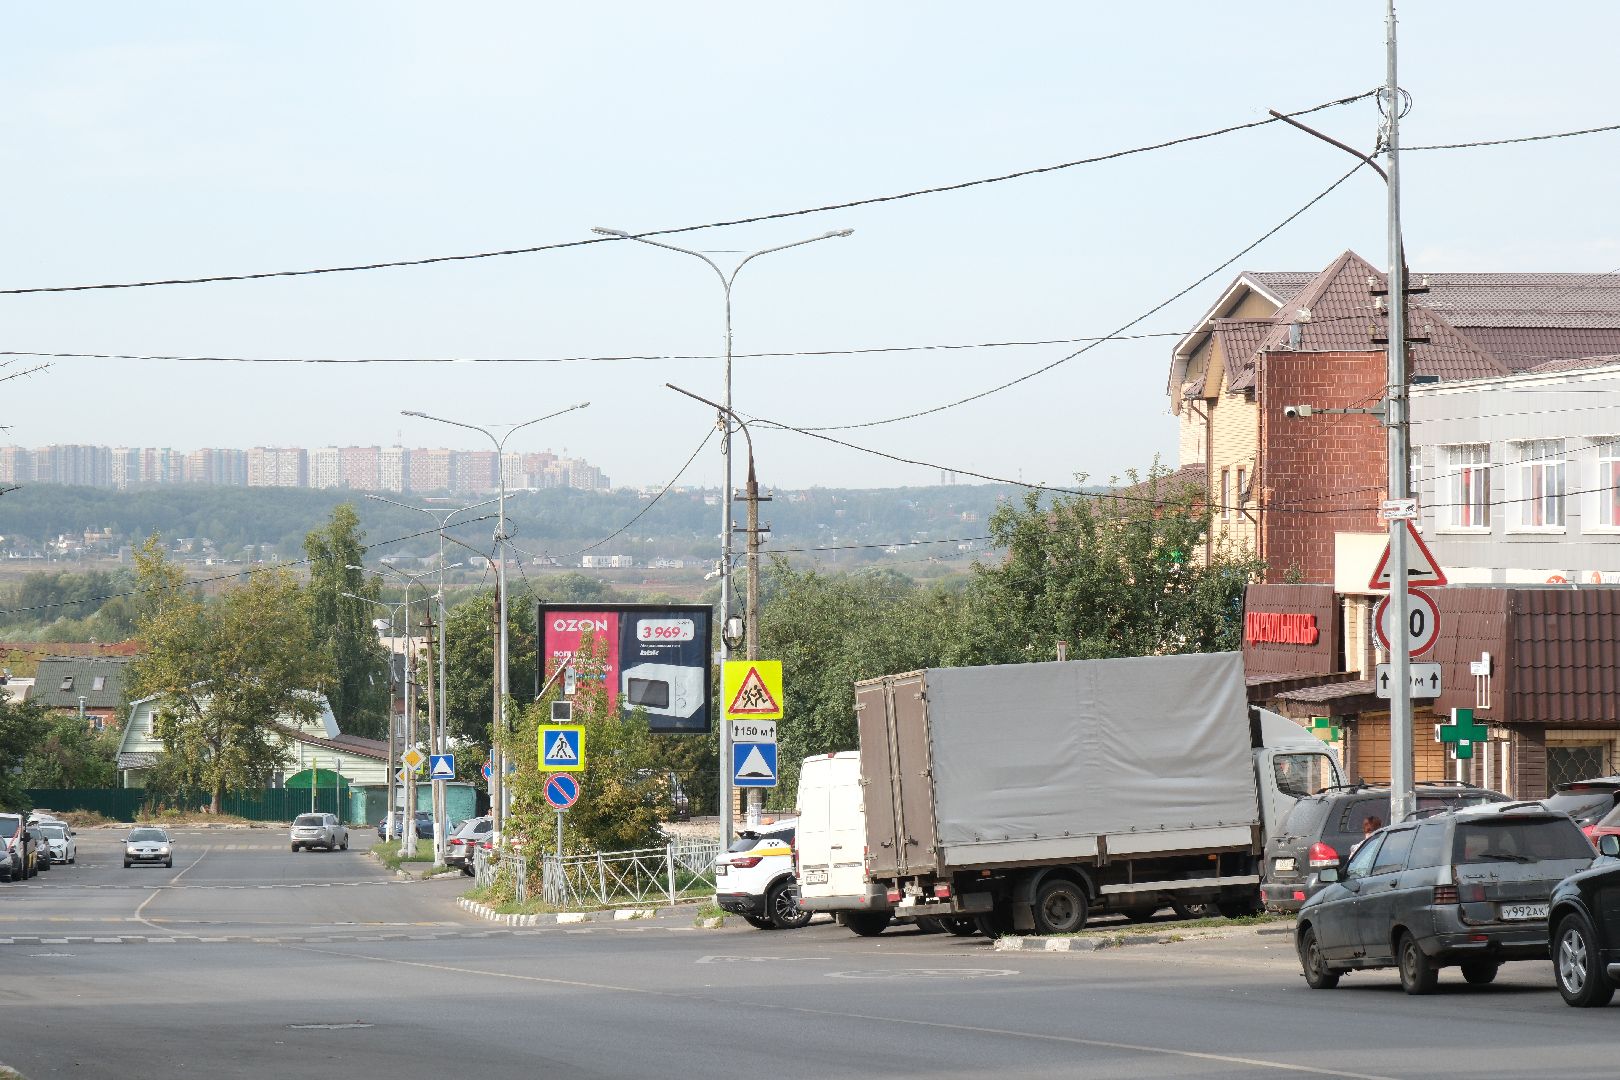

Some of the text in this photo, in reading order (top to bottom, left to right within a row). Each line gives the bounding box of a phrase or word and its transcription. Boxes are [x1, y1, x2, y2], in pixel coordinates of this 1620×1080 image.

[553, 619, 608, 632] OZON
[643, 626, 652, 638] 3
[655, 626, 681, 638] 969
[740, 726, 758, 736] 150
